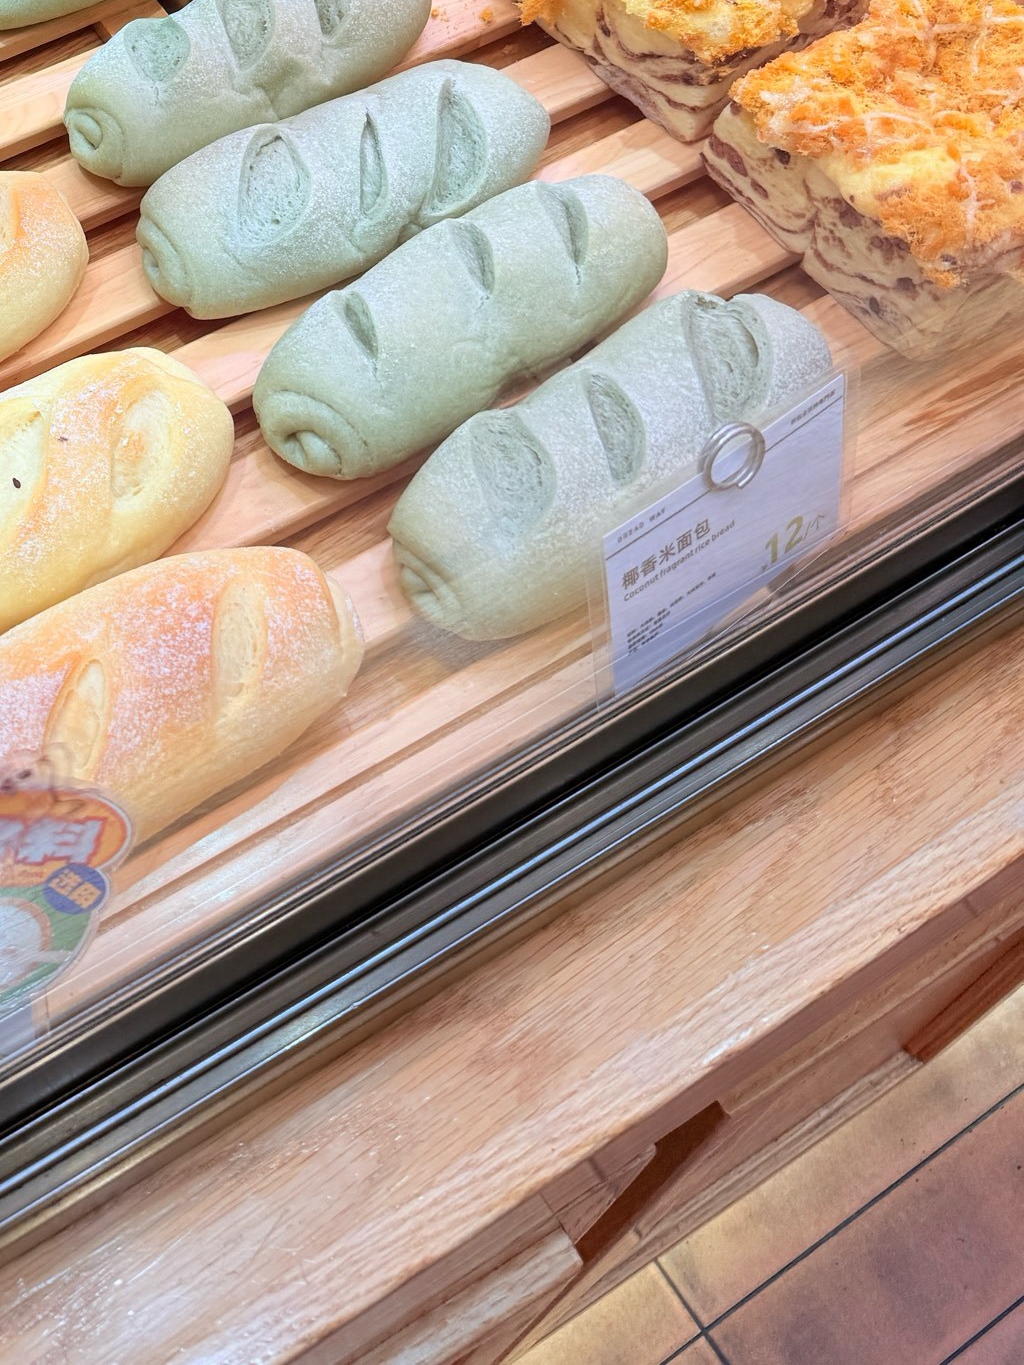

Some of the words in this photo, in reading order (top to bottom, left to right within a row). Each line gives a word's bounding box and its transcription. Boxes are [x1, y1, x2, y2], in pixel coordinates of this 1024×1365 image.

[622, 518, 711, 590] 椰香米面包
[623, 572, 660, 602] Coconut
[660, 548, 695, 579] fragrant
[695, 538, 711, 555] rice
[711, 519, 736, 543] bread
